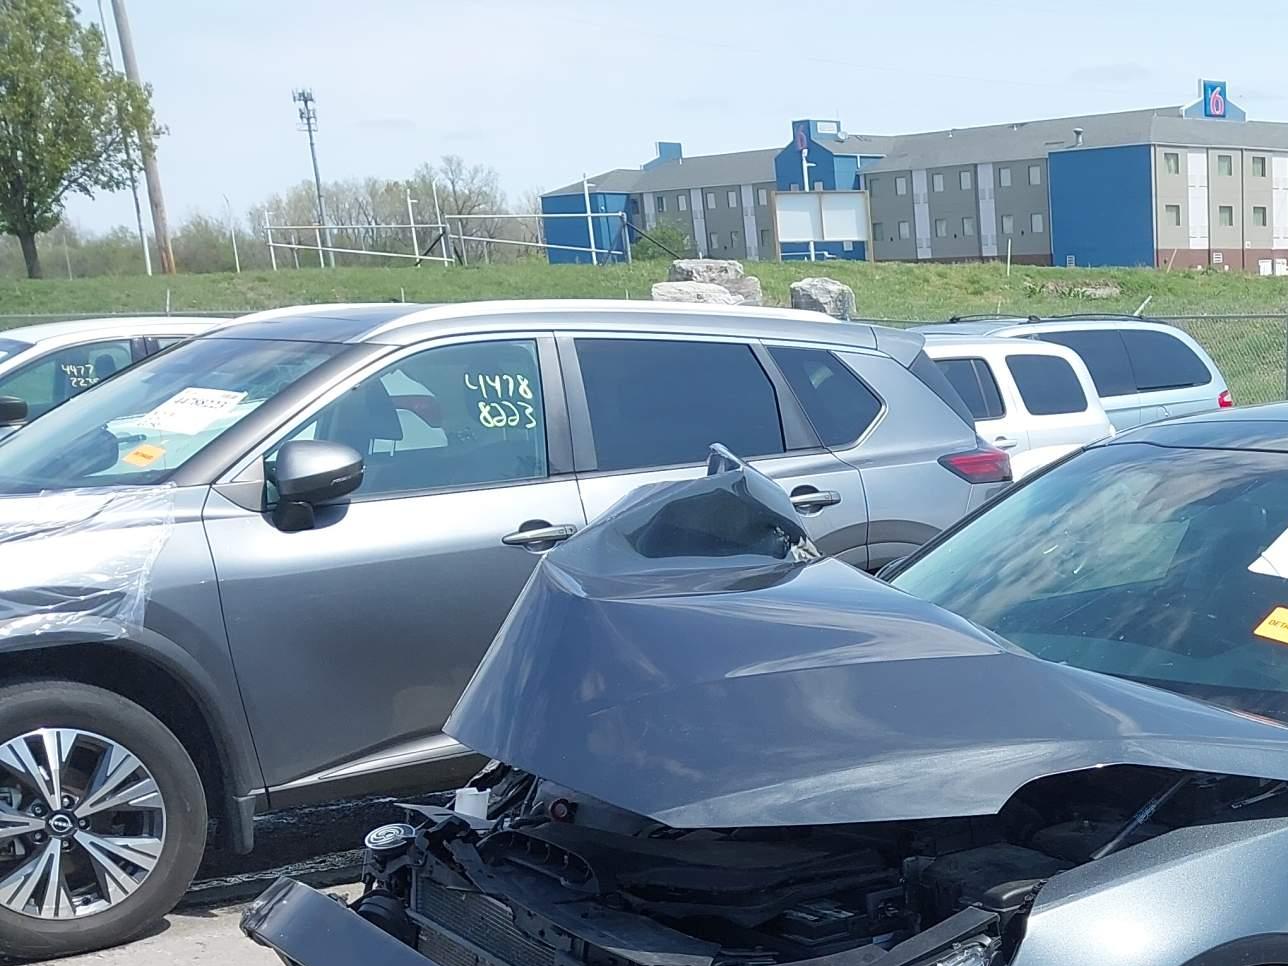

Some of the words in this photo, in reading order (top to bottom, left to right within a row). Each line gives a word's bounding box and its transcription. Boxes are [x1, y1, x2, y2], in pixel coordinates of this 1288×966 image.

[1210, 86, 1225, 115] 6
[61, 364, 95, 377] 4477
[465, 373, 533, 399] 4478
[478, 401, 537, 428] 8223
